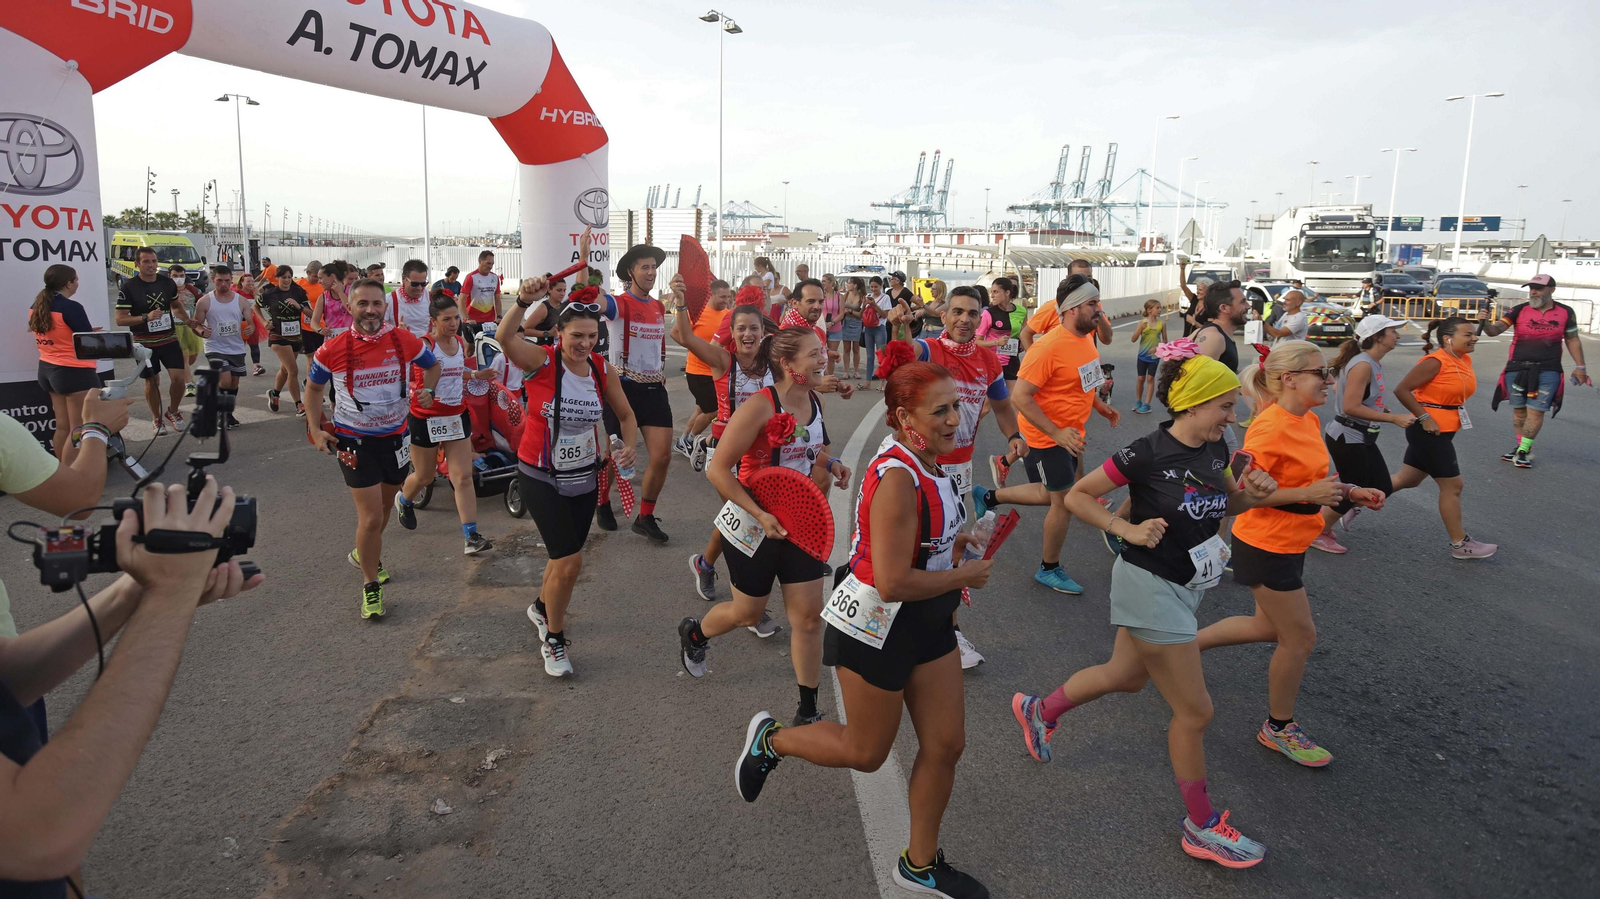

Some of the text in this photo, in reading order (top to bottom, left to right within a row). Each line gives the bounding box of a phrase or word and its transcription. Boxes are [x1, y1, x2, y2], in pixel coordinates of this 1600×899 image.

[286, 9, 488, 90] A. TOMAX
[220, 325, 232, 333] 855
[355, 369, 389, 381] RUNNING
[358, 376, 397, 388] ALGECIRAS
[560, 397, 598, 407] ALGECIRAS
[431, 425, 448, 436] 665
[560, 446, 581, 460] 365
[722, 507, 741, 531] 230
[1202, 559, 1213, 579] 41
[832, 589, 860, 619] 366
